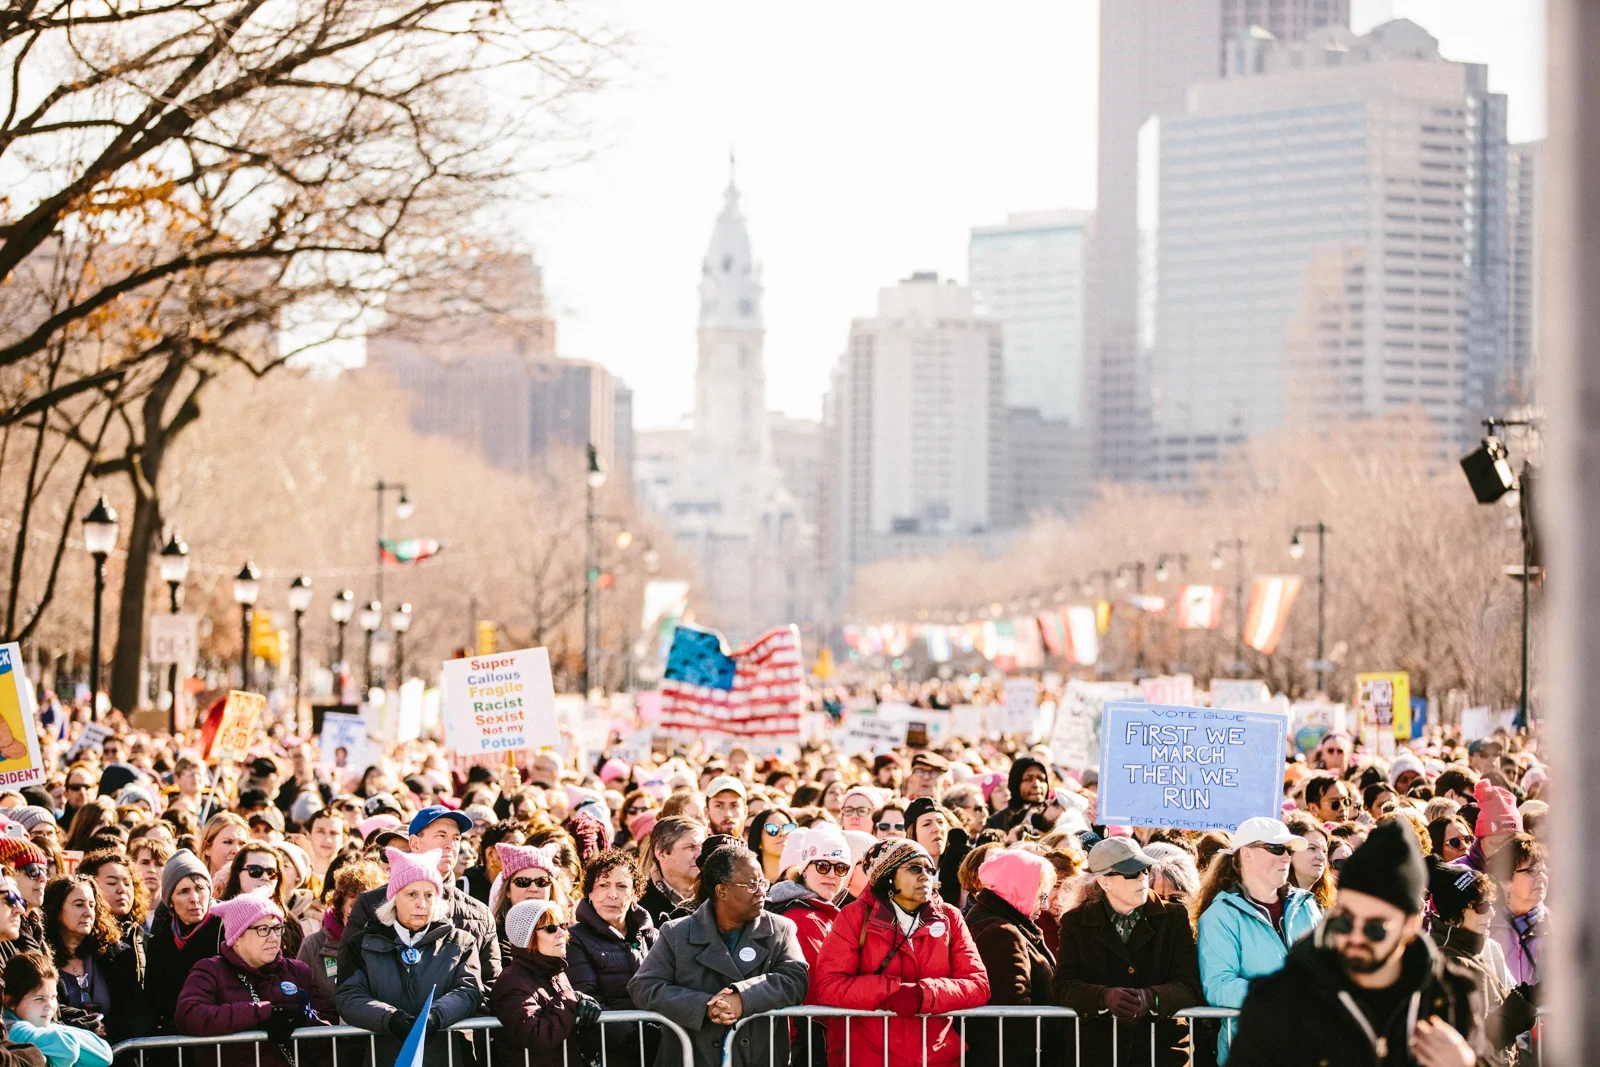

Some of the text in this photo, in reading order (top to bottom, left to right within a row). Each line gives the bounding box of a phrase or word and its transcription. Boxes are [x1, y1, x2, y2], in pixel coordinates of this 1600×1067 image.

[471, 657, 516, 671] Super
[467, 672, 521, 685] Callous
[469, 682, 523, 698] Fragile
[473, 697, 523, 713] Racist
[475, 710, 525, 726] Sexist
[1151, 709, 1245, 722] VOTE BLUE
[482, 724, 524, 736] Not my
[1125, 721, 1246, 746] FIRST WE
[481, 736, 525, 750] Potus
[1151, 745, 1225, 765] MARCH
[0, 767, 40, 785] SIDENT
[1123, 764, 1239, 787] THEN WE
[1163, 786, 1211, 811] RUN
[1130, 816, 1238, 831] FOR EVERYTHING
